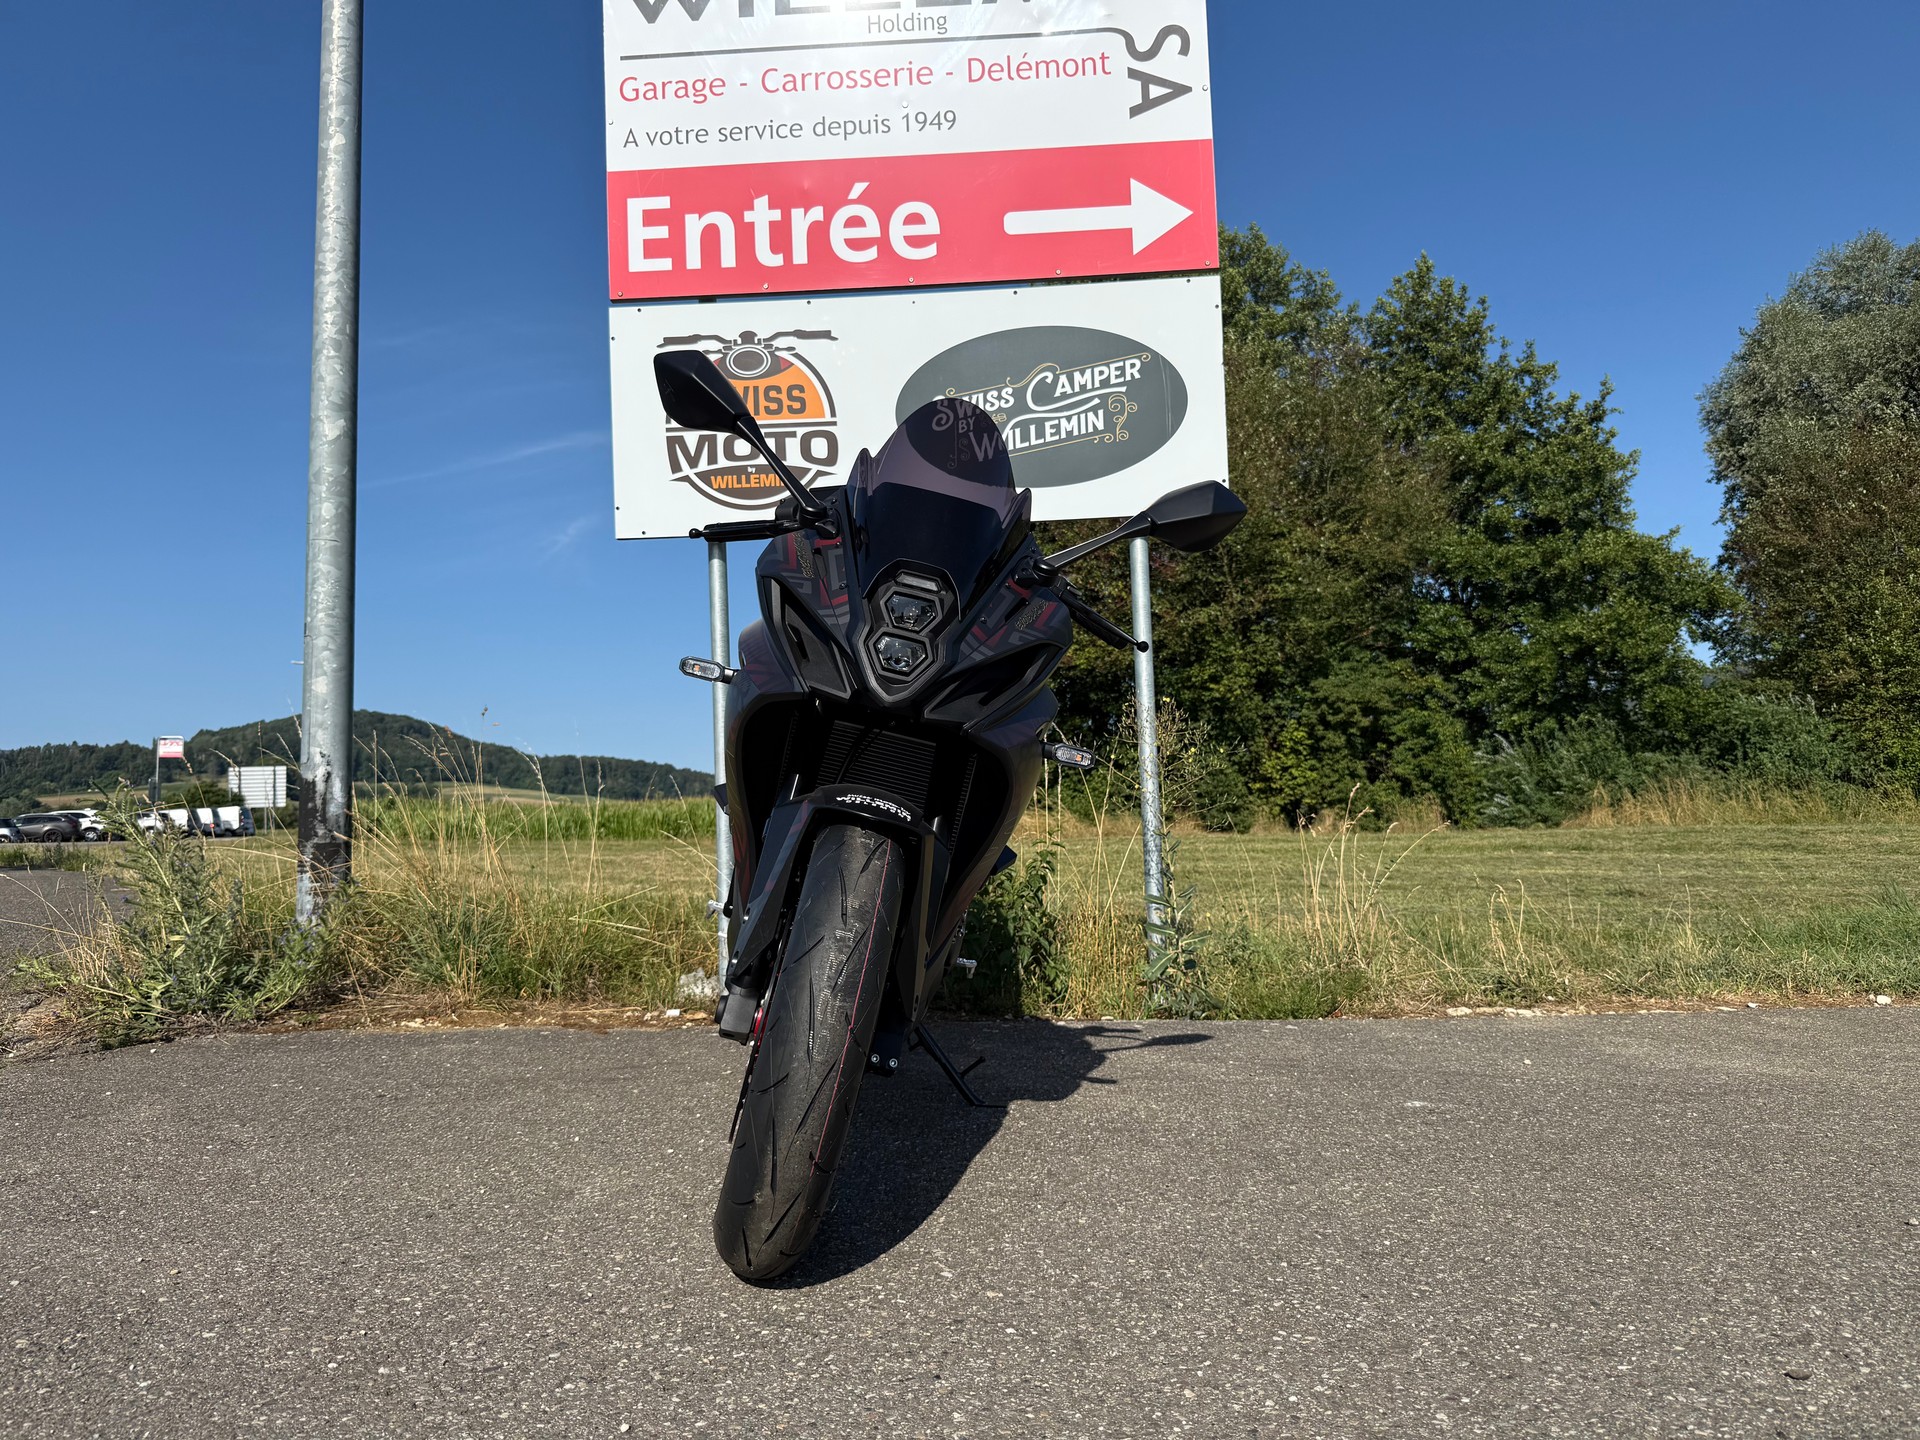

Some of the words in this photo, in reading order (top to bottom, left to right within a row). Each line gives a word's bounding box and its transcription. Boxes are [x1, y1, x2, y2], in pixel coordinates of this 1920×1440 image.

[867, 13, 948, 34] Holding
[619, 76, 727, 104] Garage
[761, 61, 934, 93] Carrosserie
[967, 52, 1112, 83] Delémont
[1125, 24, 1192, 119] SA
[623, 128, 639, 148] A
[645, 126, 709, 146] votre
[718, 119, 803, 143] service
[812, 114, 891, 141] depuis
[901, 109, 957, 133] 1949
[626, 182, 941, 272] Entrée
[735, 384, 807, 417] ISS
[1026, 358, 1142, 411] CAMPER
[958, 417, 975, 434] BY
[969, 409, 1105, 462] WILLEMIN
[666, 430, 839, 475] MOTO
[710, 473, 785, 490] WILLEMI
